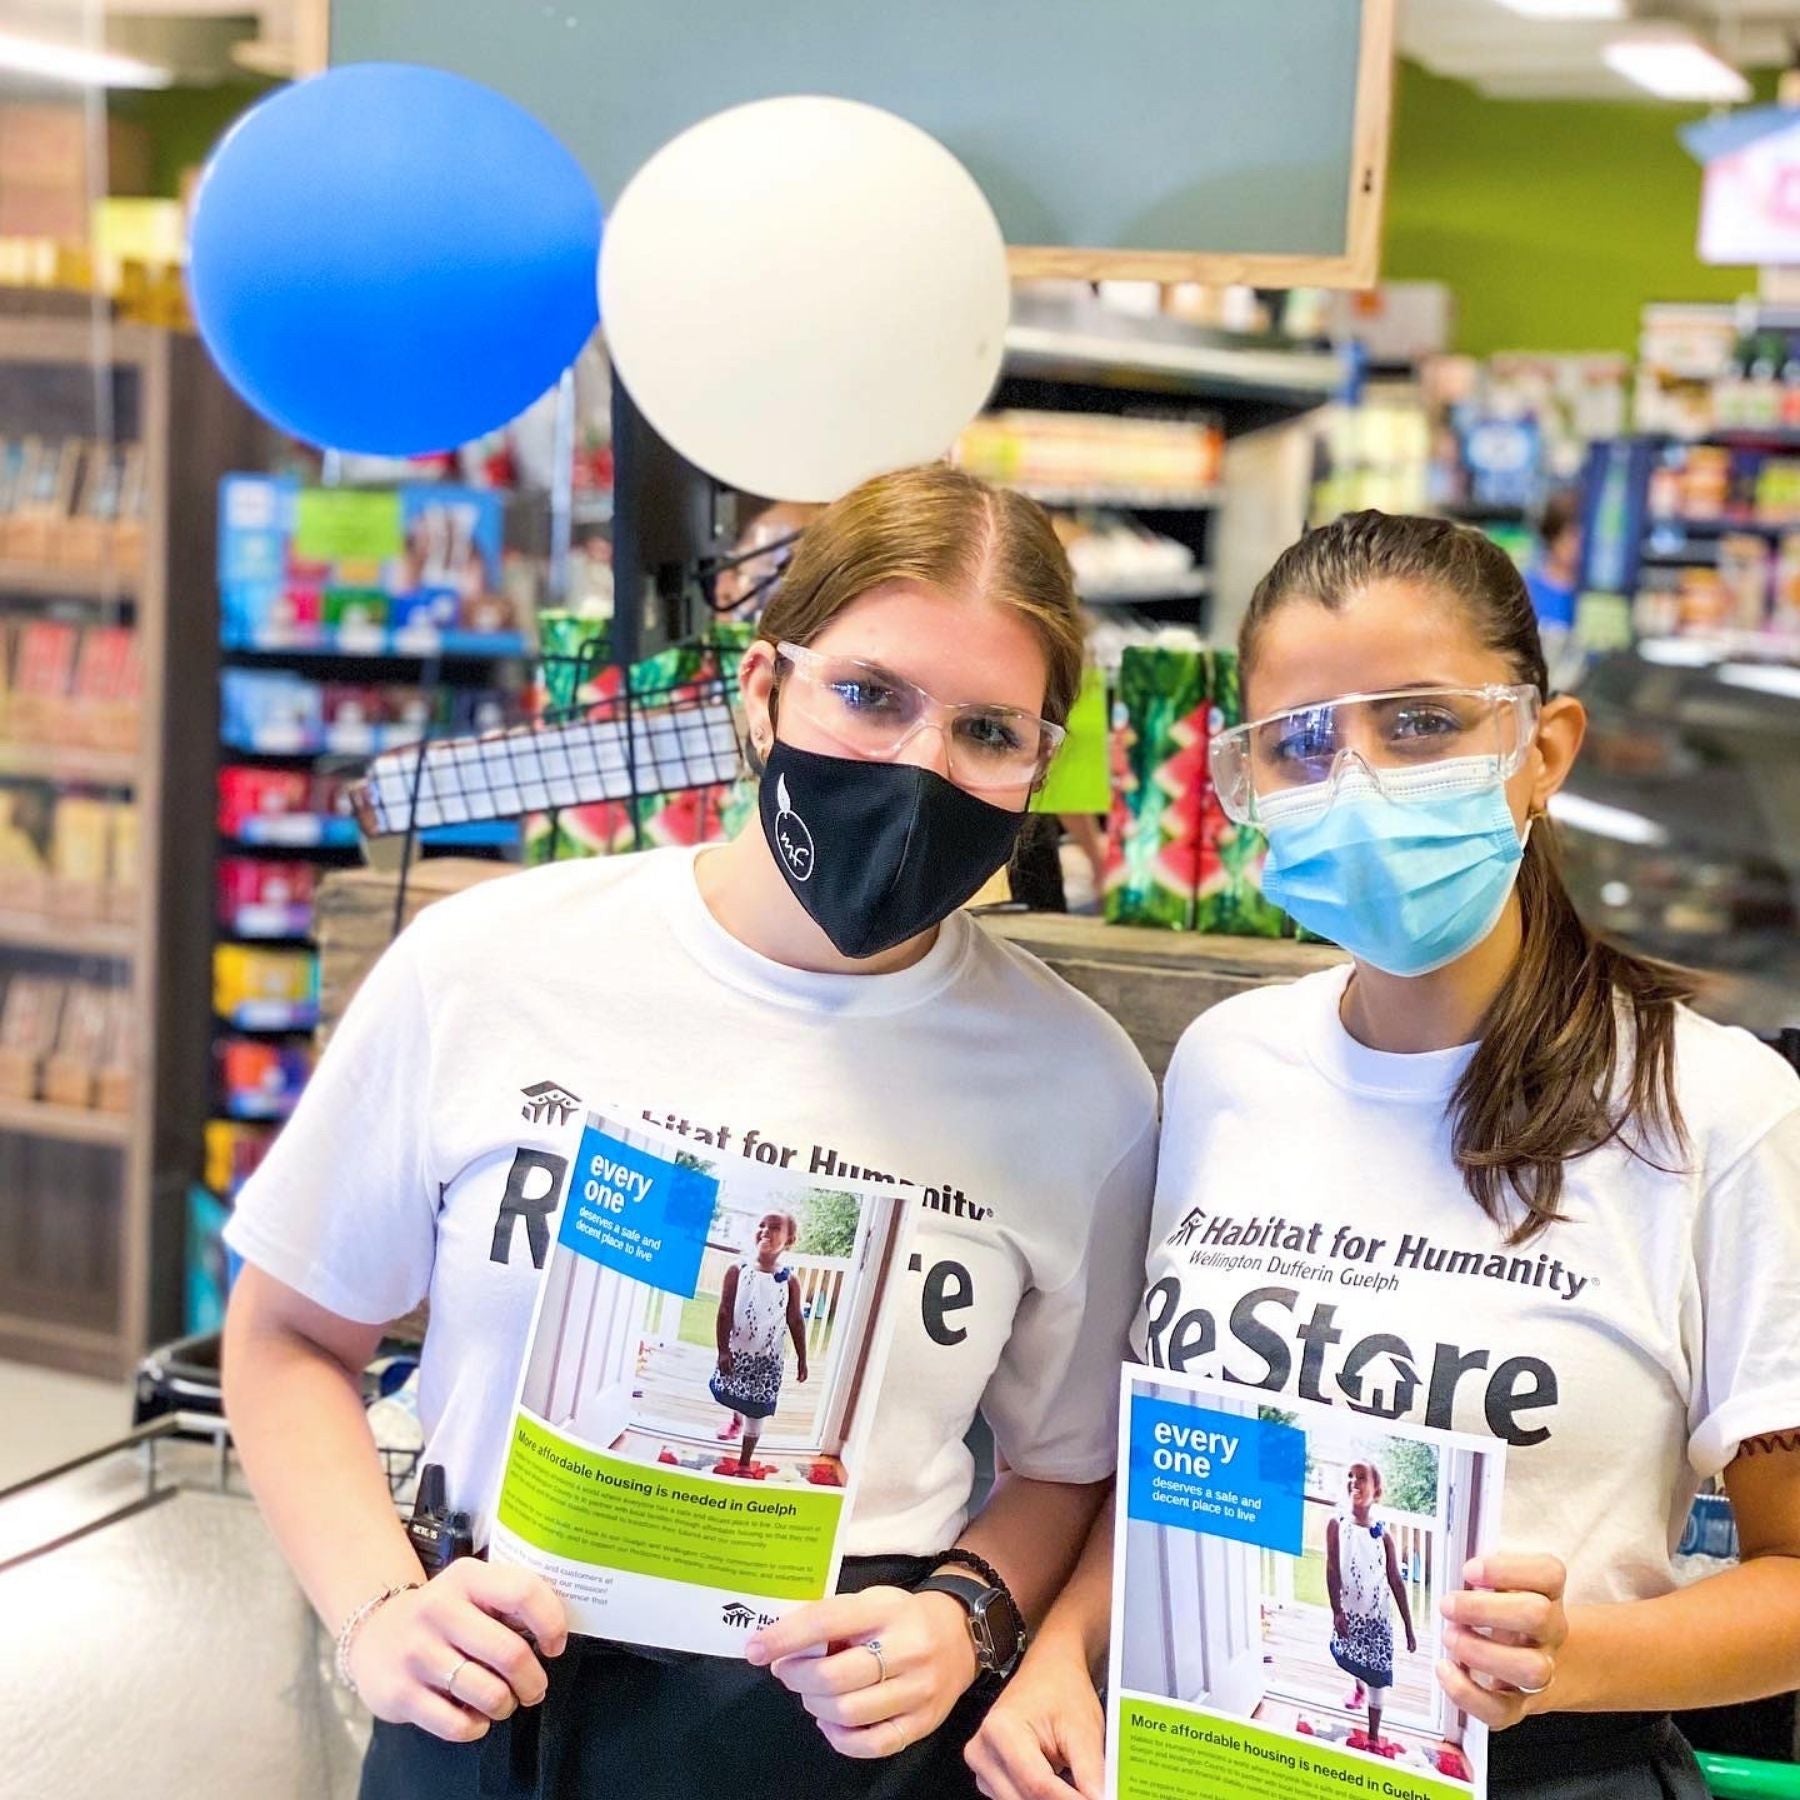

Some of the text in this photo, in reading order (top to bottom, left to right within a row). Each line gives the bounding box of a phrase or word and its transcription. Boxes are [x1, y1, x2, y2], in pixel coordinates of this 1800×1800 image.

[743, 1129, 798, 1168] for
[584, 1179, 625, 1214] one
[590, 1154, 653, 1202] every
[576, 1220, 653, 1262] decent place to live
[579, 1206, 662, 1250] deserves a safe and
[1199, 1215, 1323, 1254] Habitat
[1329, 1225, 1387, 1263] for
[1189, 1250, 1400, 1293] Wellington Dufferin Guelph
[1146, 1276, 1558, 1447] ReStore
[1153, 1448, 1211, 1478] one
[1154, 1422, 1239, 1464] every
[518, 1430, 797, 1517] More affordable housing is needed in Guelph
[1152, 1476, 1262, 1510] deserves a safe and
[1152, 1490, 1256, 1521] decent place to live
[1131, 1713, 1167, 1733] More
[1170, 1724, 1241, 1751] affordable
[1243, 1741, 1296, 1769] housing
[1299, 1756, 1310, 1771] is
[1313, 1763, 1364, 1786] needed
[1367, 1777, 1379, 1791] in
